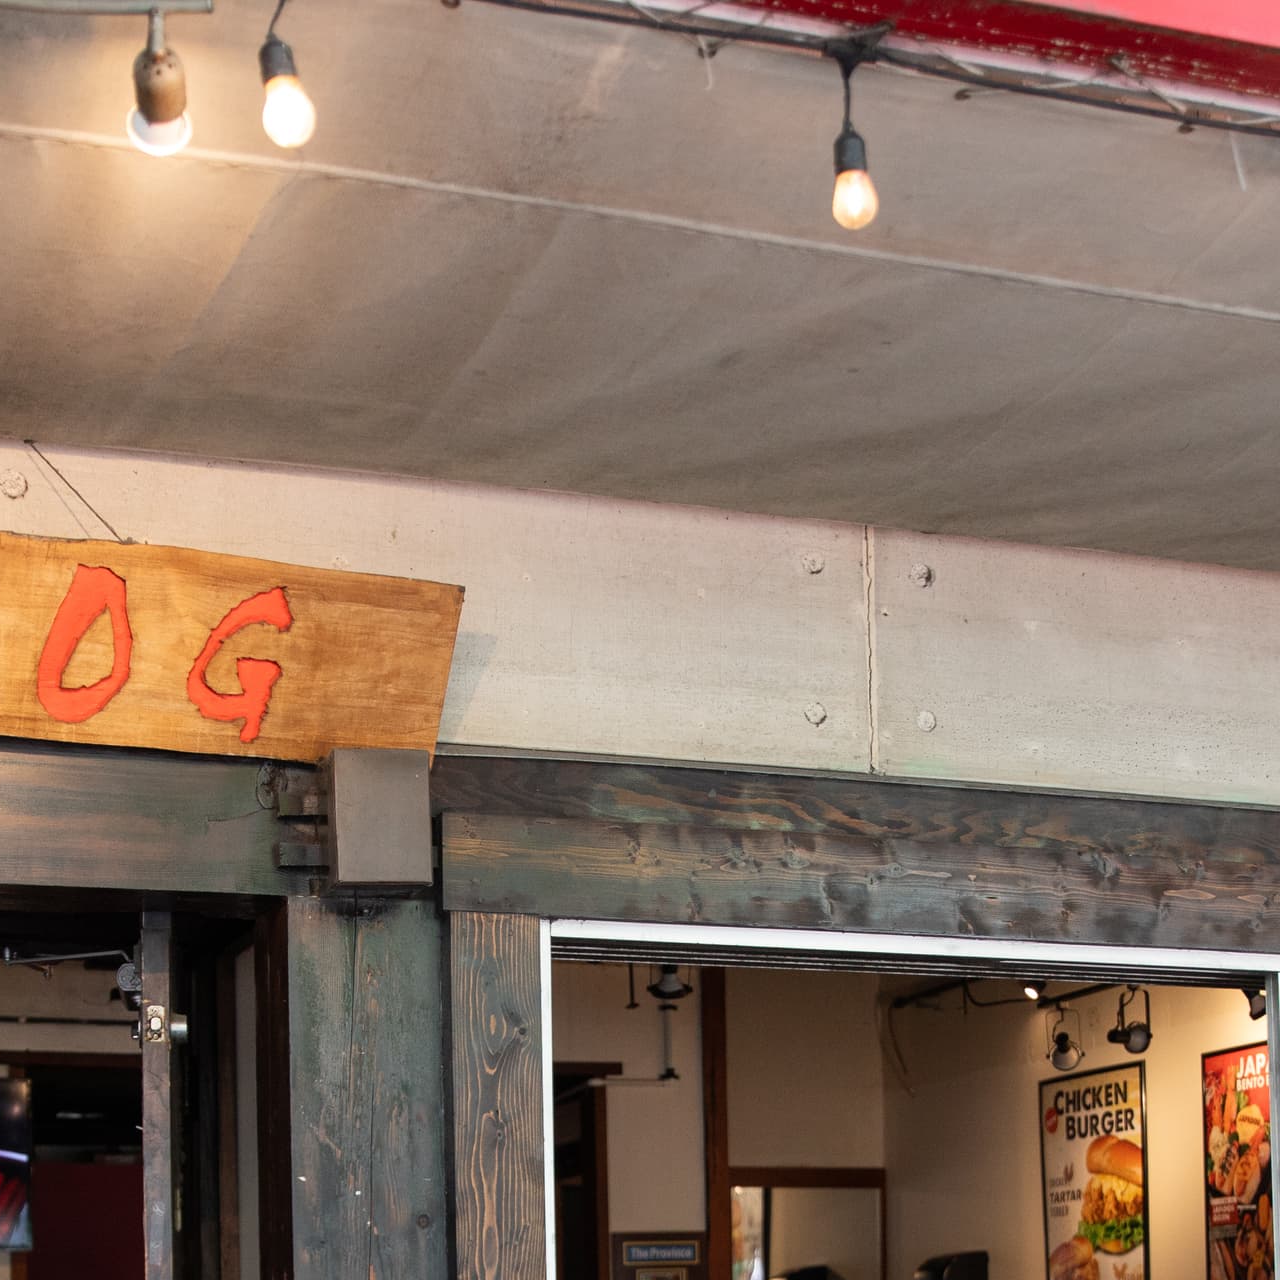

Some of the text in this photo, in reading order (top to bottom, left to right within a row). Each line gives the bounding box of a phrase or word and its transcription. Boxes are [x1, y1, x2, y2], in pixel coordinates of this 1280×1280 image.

[1053, 1081, 1128, 1115] CHICKEN
[1236, 1076, 1265, 1091] BENTO
[1065, 1108, 1135, 1140] BURGER
